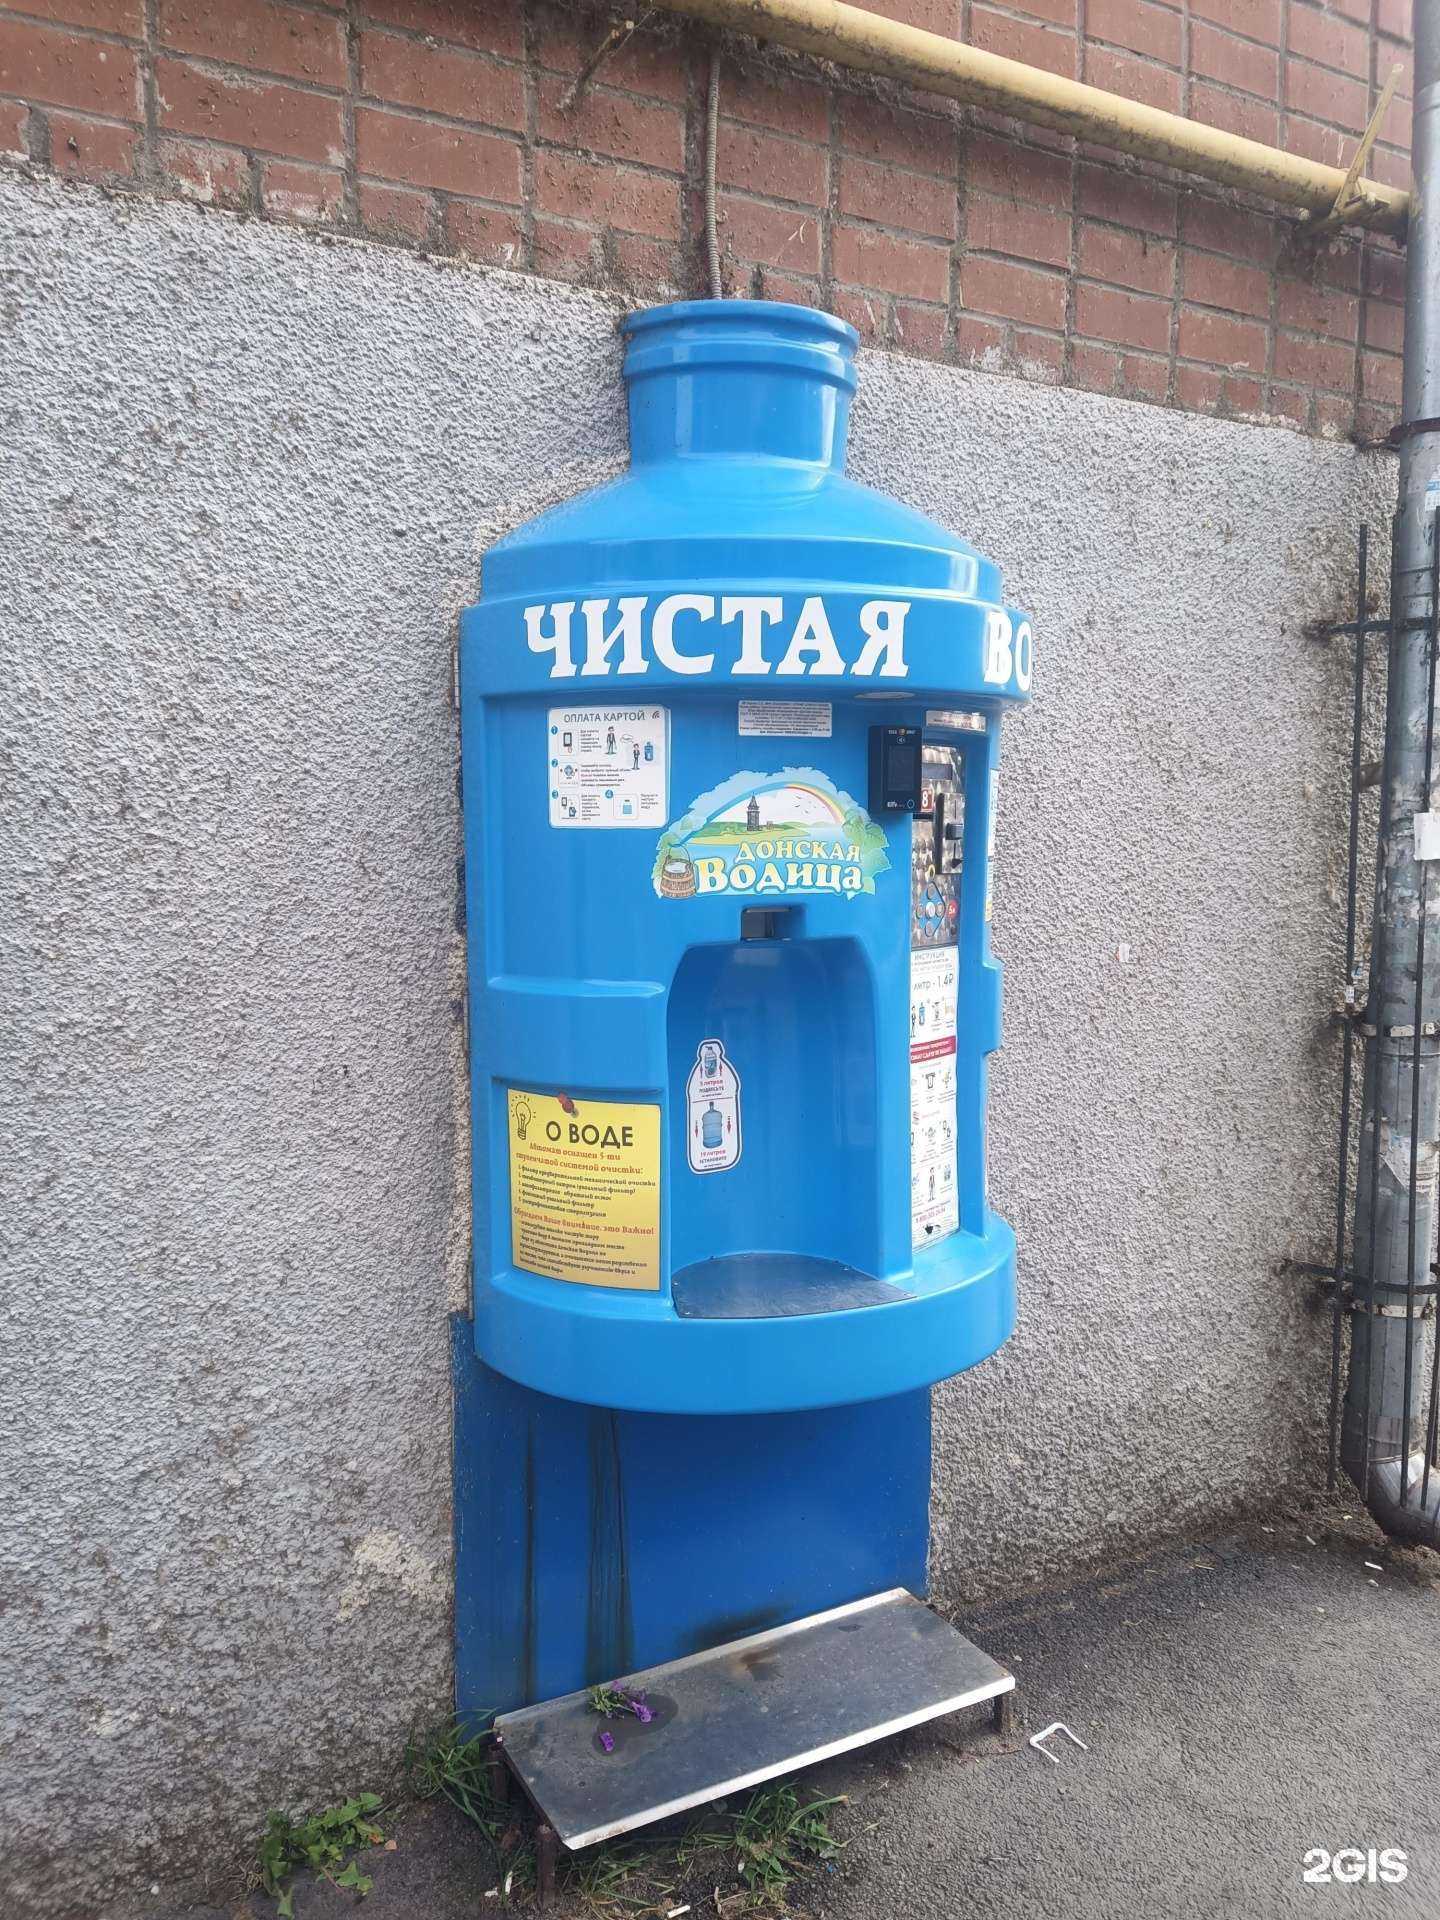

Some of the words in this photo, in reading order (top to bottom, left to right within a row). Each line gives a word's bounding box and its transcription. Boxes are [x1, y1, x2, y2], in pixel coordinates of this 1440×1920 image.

[523, 594, 912, 678] ЧИСТАЯ
[564, 713, 601, 723] ОПЛАТА
[604, 710, 646, 721] КАРТОЙ
[922, 791, 929, 807] 8
[734, 840, 861, 863] ДОНСКАЯ
[694, 857, 864, 893] Водица
[546, 1120, 561, 1141] О
[569, 1123, 633, 1149] ВОДЕ
